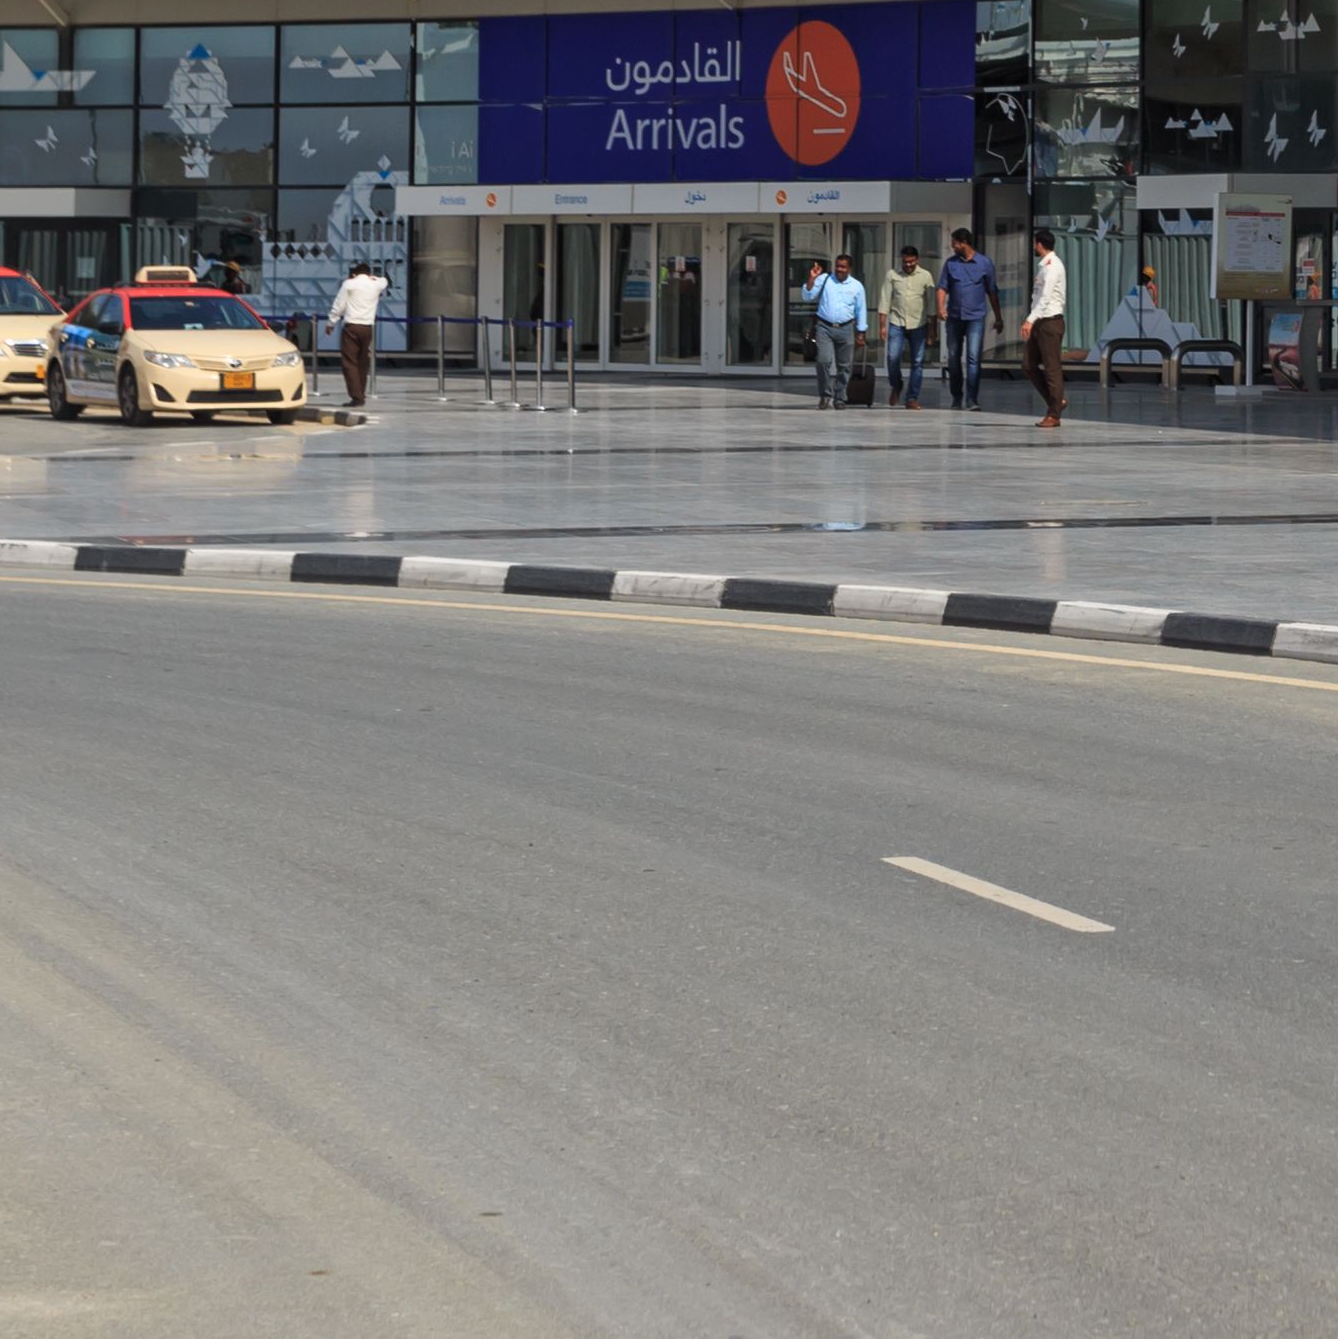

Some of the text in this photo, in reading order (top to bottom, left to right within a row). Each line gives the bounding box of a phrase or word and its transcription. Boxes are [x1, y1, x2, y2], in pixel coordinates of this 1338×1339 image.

[605, 39, 741, 94] القادمون
[605, 103, 745, 152] Arrivals
[438, 194, 467, 206] Arrivals
[554, 193, 589, 205] Entrance
